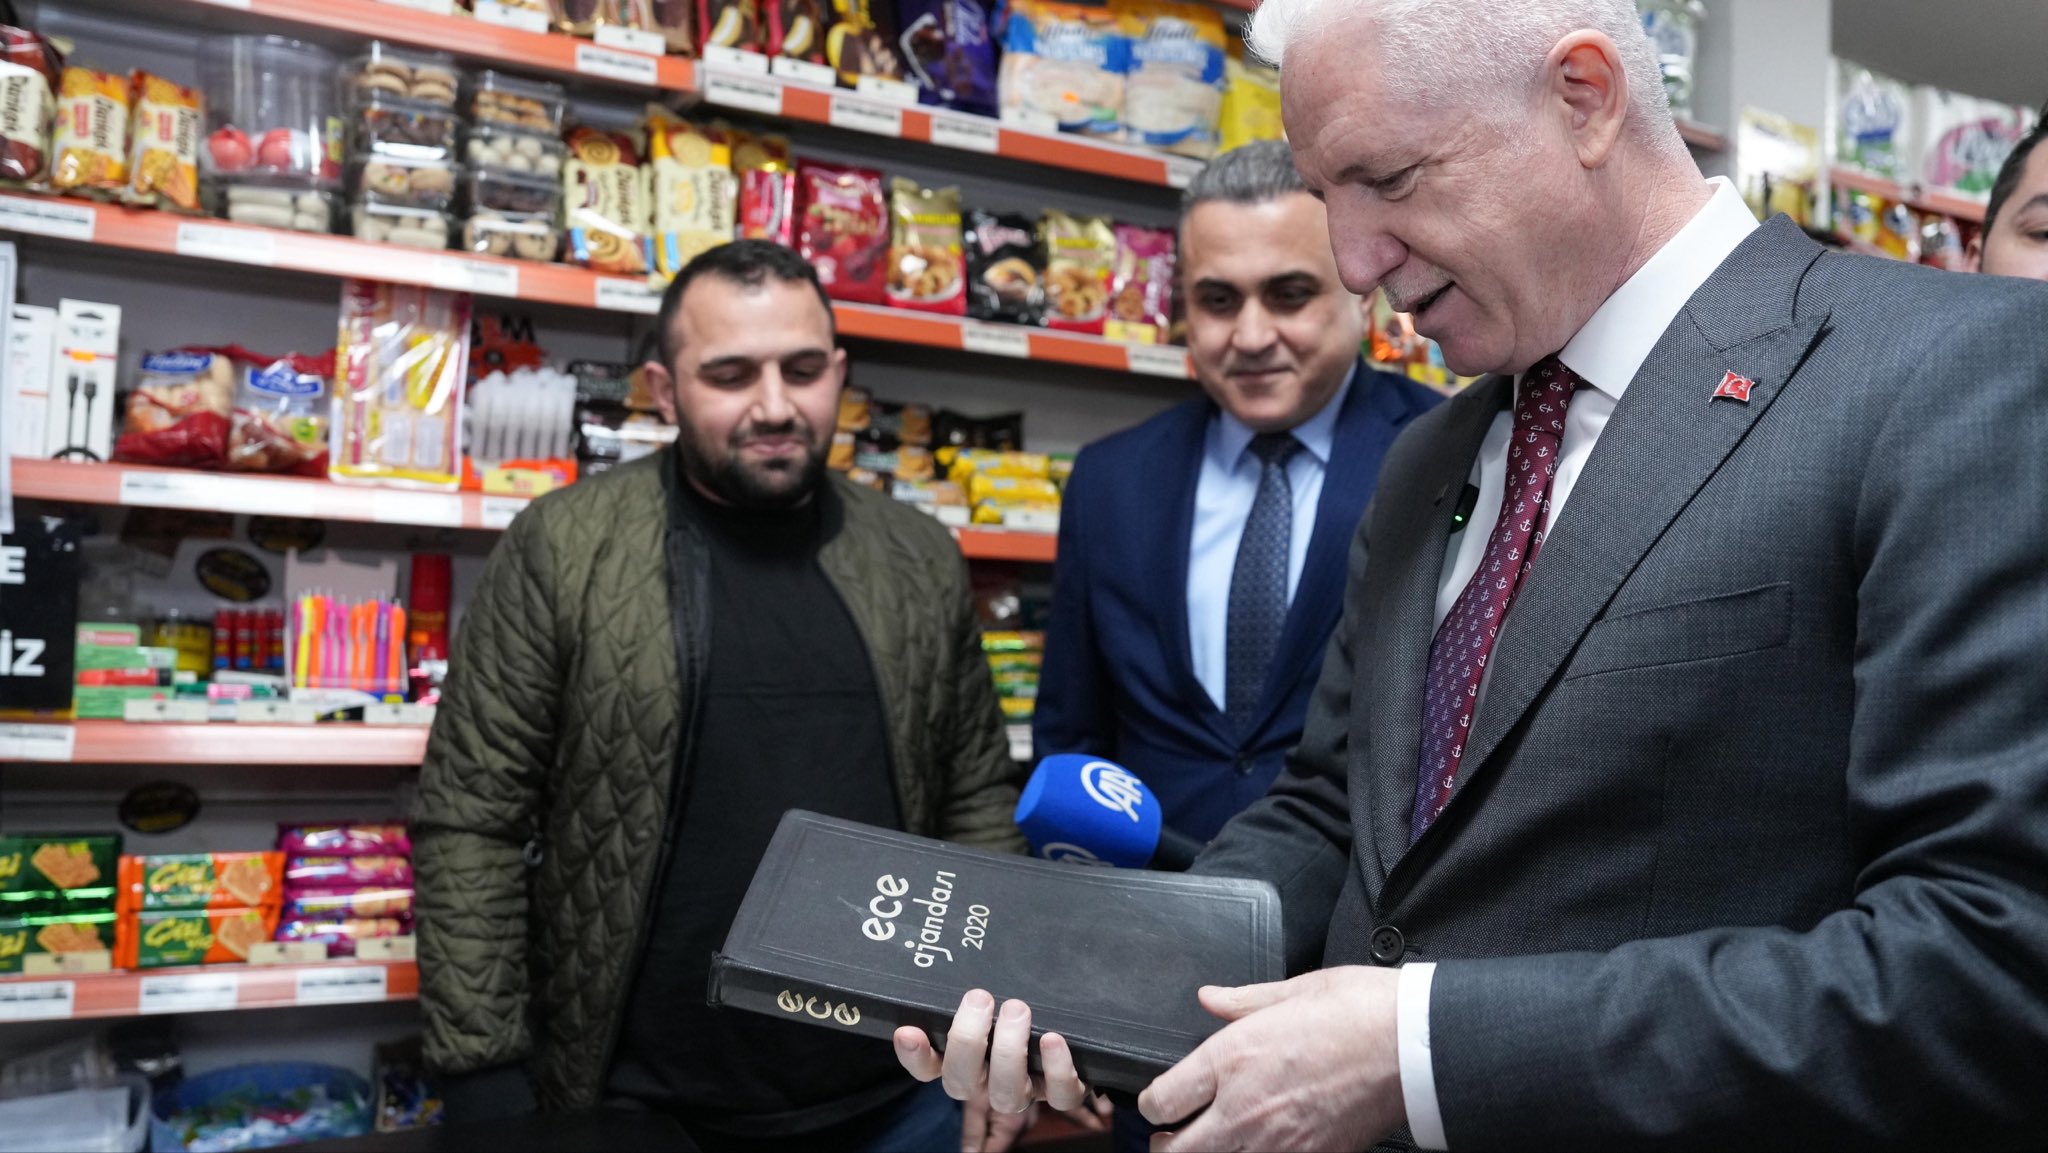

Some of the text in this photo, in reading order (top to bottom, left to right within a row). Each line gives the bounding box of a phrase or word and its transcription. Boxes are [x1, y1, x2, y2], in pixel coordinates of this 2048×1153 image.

[861, 874, 910, 941] ece
[904, 870, 957, 968] ajandası
[961, 904, 990, 951] 2020
[776, 989, 861, 1026] ece
